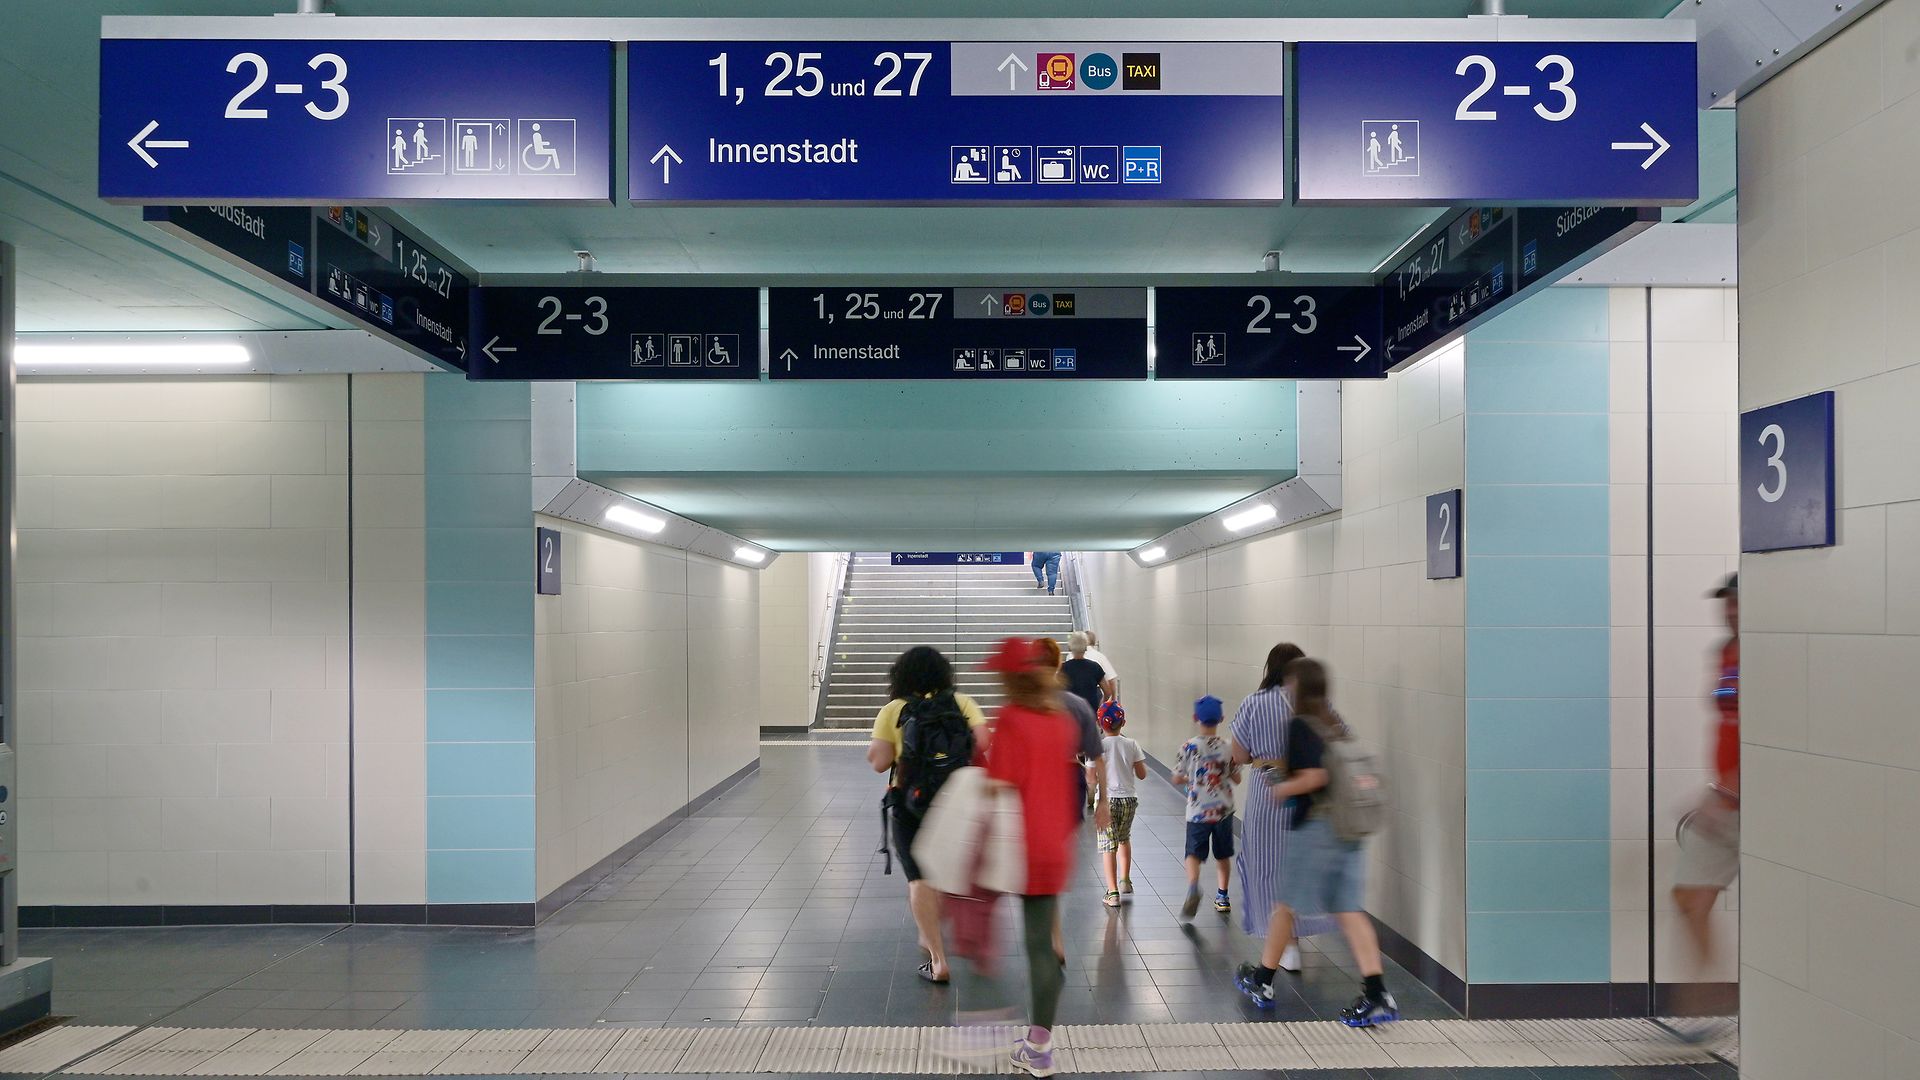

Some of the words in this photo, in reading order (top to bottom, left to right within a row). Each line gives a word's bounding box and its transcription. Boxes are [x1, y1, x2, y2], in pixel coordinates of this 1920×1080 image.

[225, 53, 350, 120] 2-3
[709, 52, 746, 104] 1,
[765, 52, 824, 97] 25
[830, 78, 865, 96] und
[873, 52, 932, 97] 27
[1088, 65, 1112, 77] Bus
[1127, 65, 1156, 78] TAXI
[1455, 55, 1577, 121] 2-3
[709, 138, 858, 164] Innenstadt
[1083, 164, 1110, 179] WC
[1125, 161, 1159, 178] P+R
[397, 240, 407, 278] 1,
[412, 249, 427, 284] 25
[438, 267, 452, 299] 27
[1398, 271, 1406, 301] 1,
[1409, 257, 1421, 292] 25
[1431, 237, 1445, 276] 27
[537, 297, 609, 336] 2-3
[814, 294, 836, 324] 1,
[845, 294, 880, 320] 25
[883, 308, 904, 319] und
[908, 294, 943, 319] 27
[1032, 300, 1047, 309] Bus
[1055, 300, 1073, 309] TAXI
[1246, 295, 1317, 334] 2-3
[416, 308, 452, 343] Innenstadt
[814, 344, 900, 359] Innenstadt
[1030, 359, 1046, 369] WC
[1055, 357, 1075, 368] P+R
[1757, 424, 1787, 503] 3
[1438, 502, 1451, 551] 2
[545, 537, 553, 573] 2
